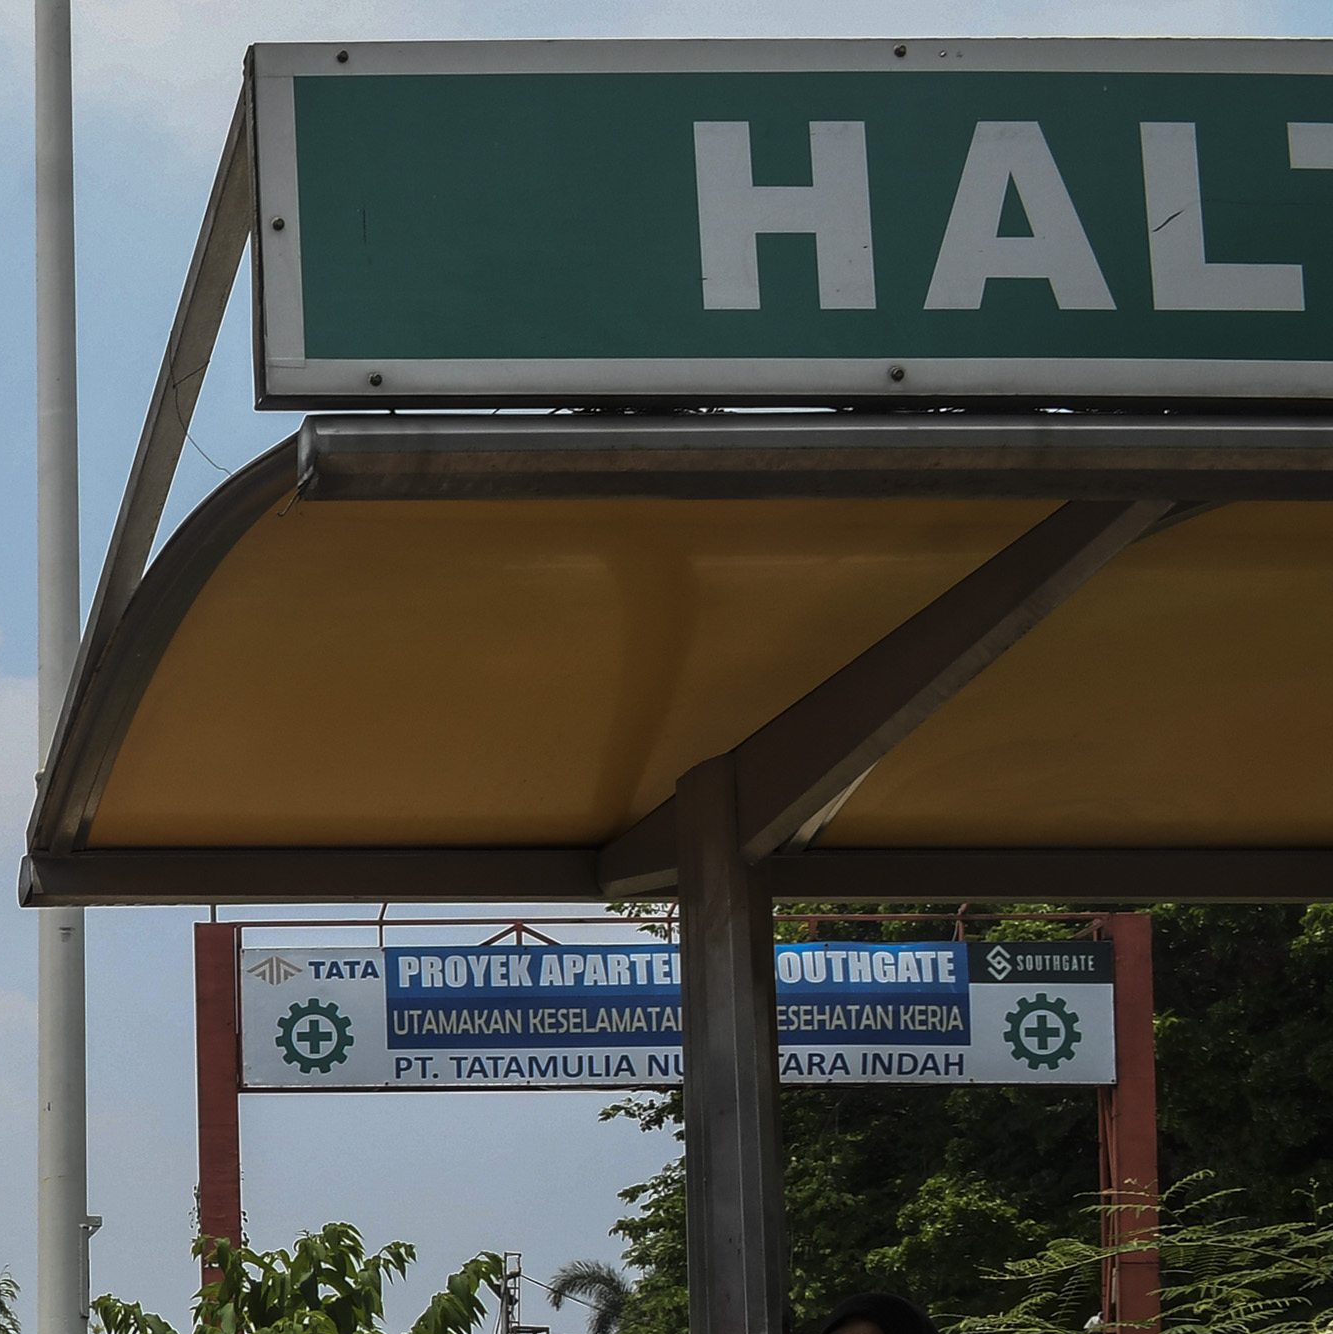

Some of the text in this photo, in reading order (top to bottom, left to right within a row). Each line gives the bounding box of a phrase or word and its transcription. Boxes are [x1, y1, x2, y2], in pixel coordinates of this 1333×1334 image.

[693, 121, 1333, 311] HAL
[309, 961, 379, 979] TATA
[399, 955, 532, 987] PROYEK
[775, 951, 955, 983] OUTHGATE
[1017, 955, 1094, 971] SOUTHGATE
[394, 1010, 521, 1034] UTAMAKAN
[777, 1005, 892, 1030] ESEHATAN
[900, 1005, 963, 1032] KERJA
[396, 1057, 438, 1079] PT.
[450, 1054, 636, 1079] TATAMULIA
[862, 1053, 963, 1075] INDAH
